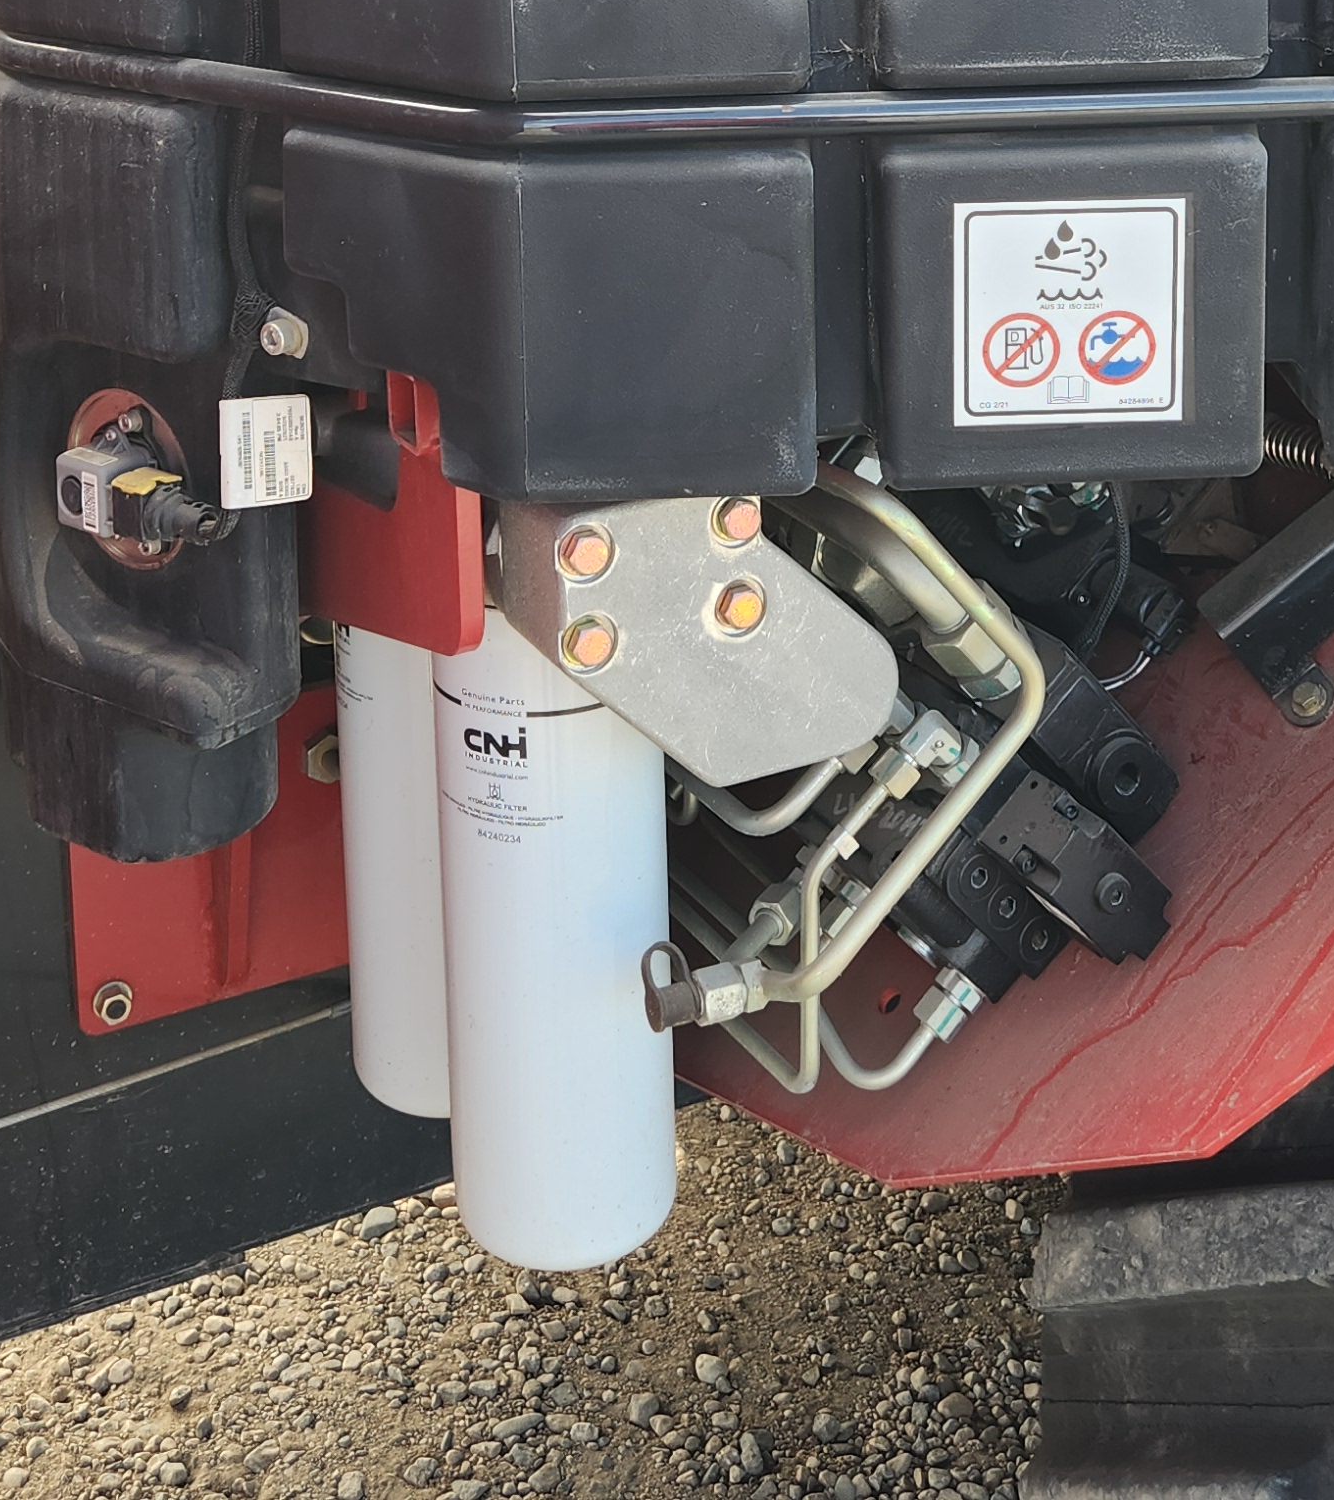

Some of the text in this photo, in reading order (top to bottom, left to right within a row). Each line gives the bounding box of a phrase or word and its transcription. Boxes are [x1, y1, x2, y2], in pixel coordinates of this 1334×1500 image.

[461, 687, 525, 706] Genuine Parts
[472, 704, 522, 718] PERFORMANCE
[464, 750, 528, 768] INDUSTRIAL
[467, 795, 502, 810] HYDRAULIC
[503, 804, 528, 812] FILTER
